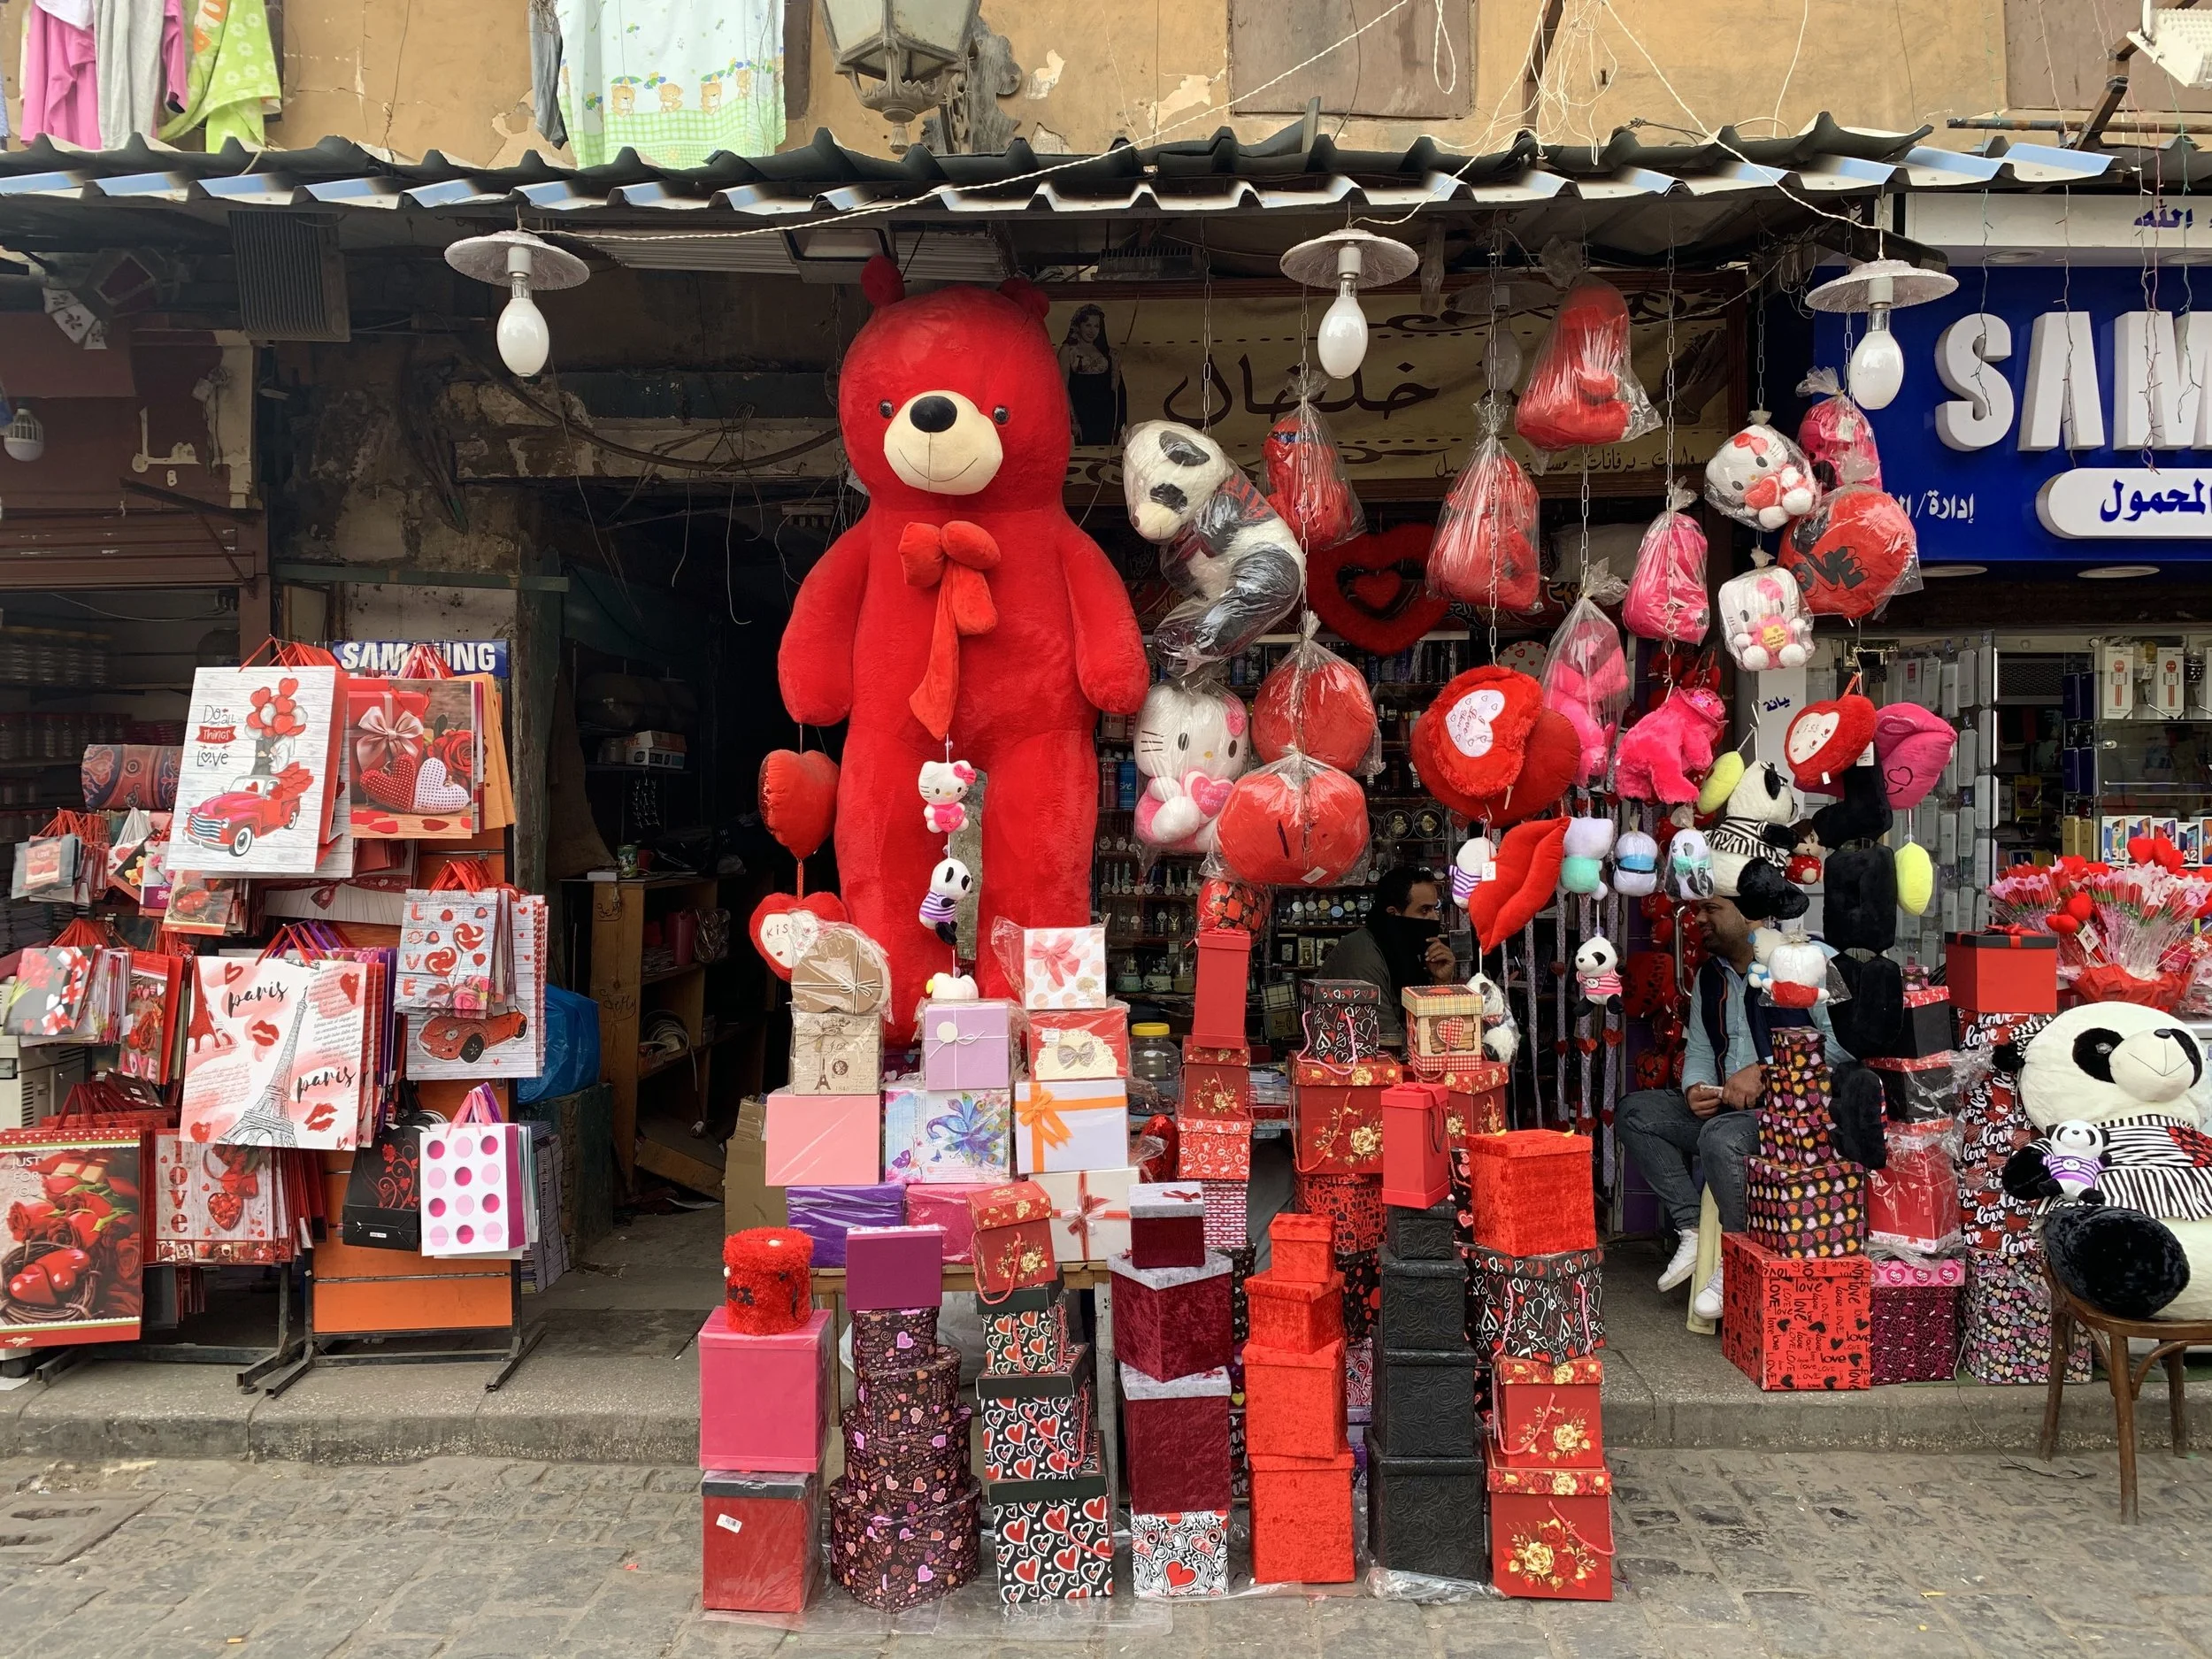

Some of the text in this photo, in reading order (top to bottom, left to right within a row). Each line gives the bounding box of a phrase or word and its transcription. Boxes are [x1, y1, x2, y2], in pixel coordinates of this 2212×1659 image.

[2133, 198, 2193, 229] الله
[2100, 475, 2212, 523] لمحمول
[341, 642, 495, 672] SAMUNG
[766, 924, 789, 939] KiS
[227, 981, 289, 1018] paris
[1964, 1025, 2000, 1047] love
[296, 1066, 357, 1104] paris
[1962, 1142, 1989, 1162] love
[11, 1156, 42, 1171] JUST
[13, 1171, 41, 1183] FOR
[12, 1187, 41, 1198] YOU
[1974, 1205, 2007, 1225] love
[2001, 1233, 2038, 1255] love
[1770, 1279, 1781, 1309] LOVE
[1795, 1278, 1824, 1293] love
[1845, 1330, 1872, 1343] love
[1819, 1352, 1847, 1363] love
